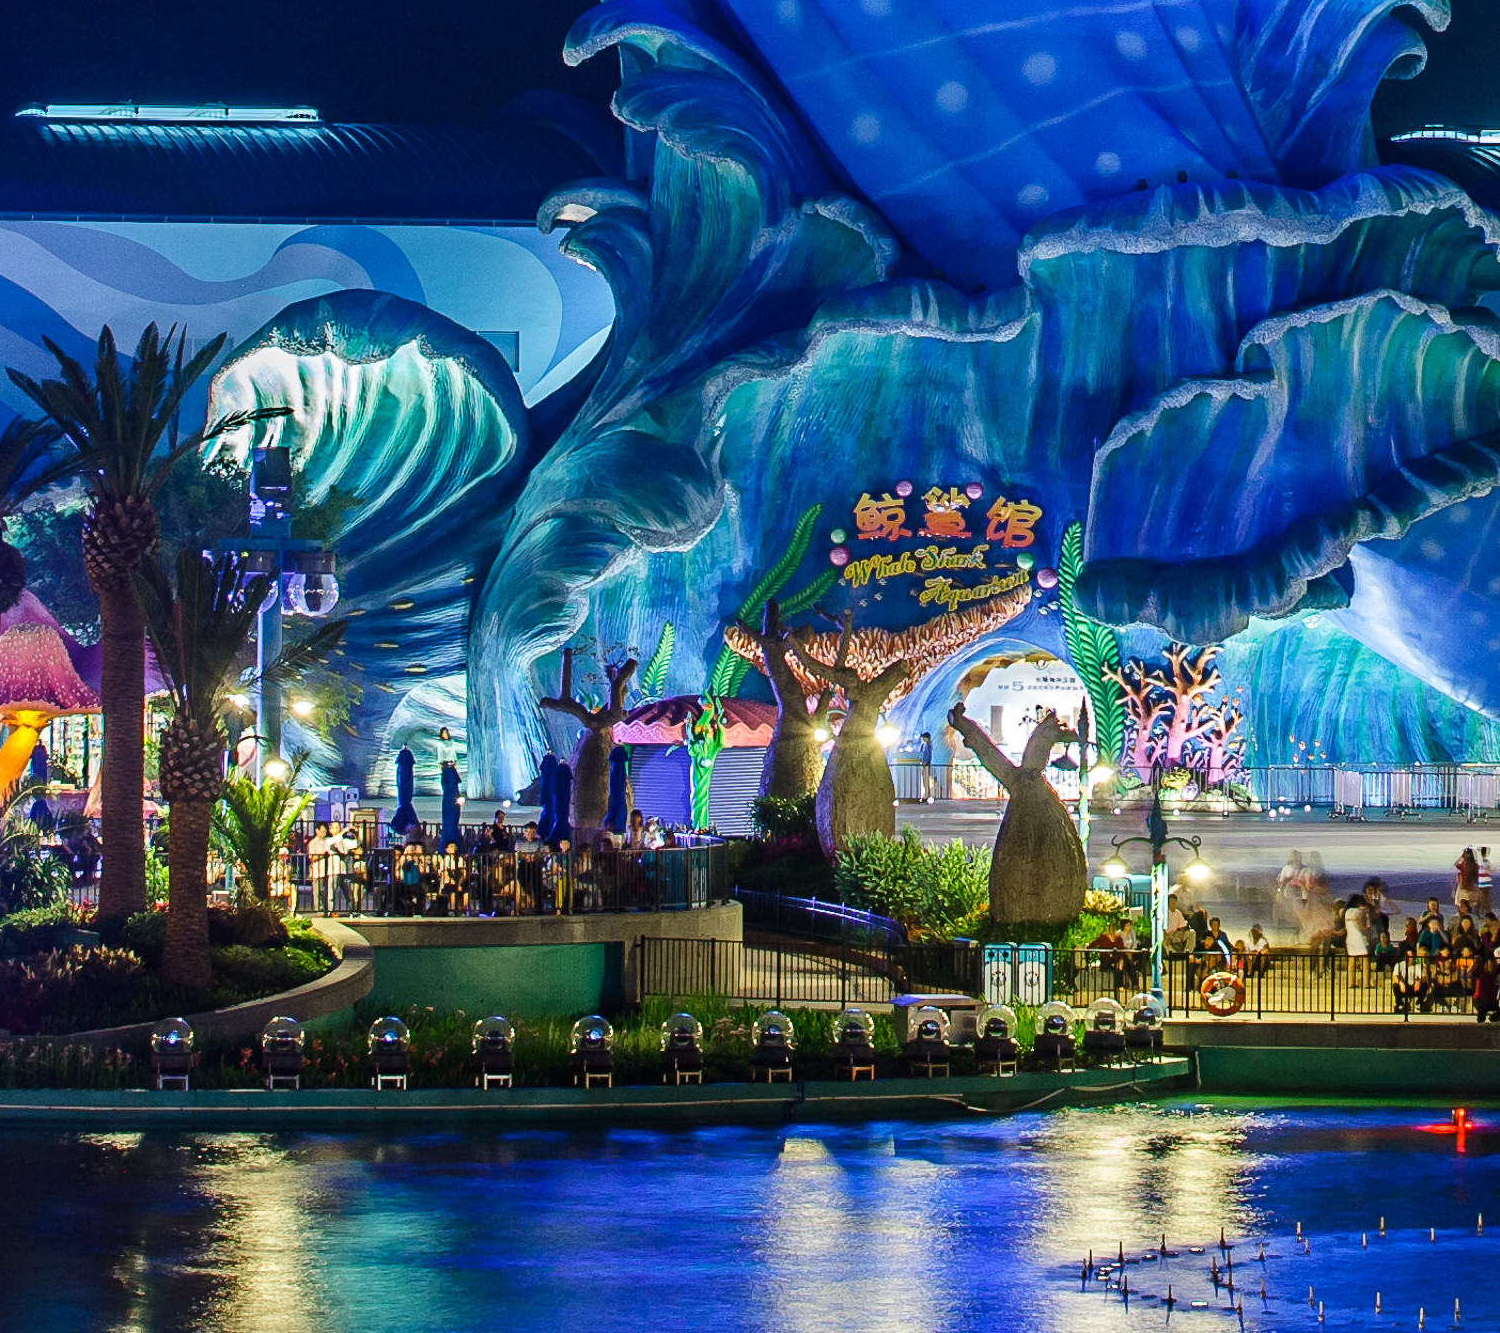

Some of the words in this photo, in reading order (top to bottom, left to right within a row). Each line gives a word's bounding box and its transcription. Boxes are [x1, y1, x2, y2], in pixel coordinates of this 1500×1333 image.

[854, 486, 1043, 548] 鲸鲨馆
[844, 552, 916, 588] Whale
[915, 544, 990, 570] Shark
[919, 568, 1030, 611] Aquarium
[1012, 680, 1024, 692] 5
